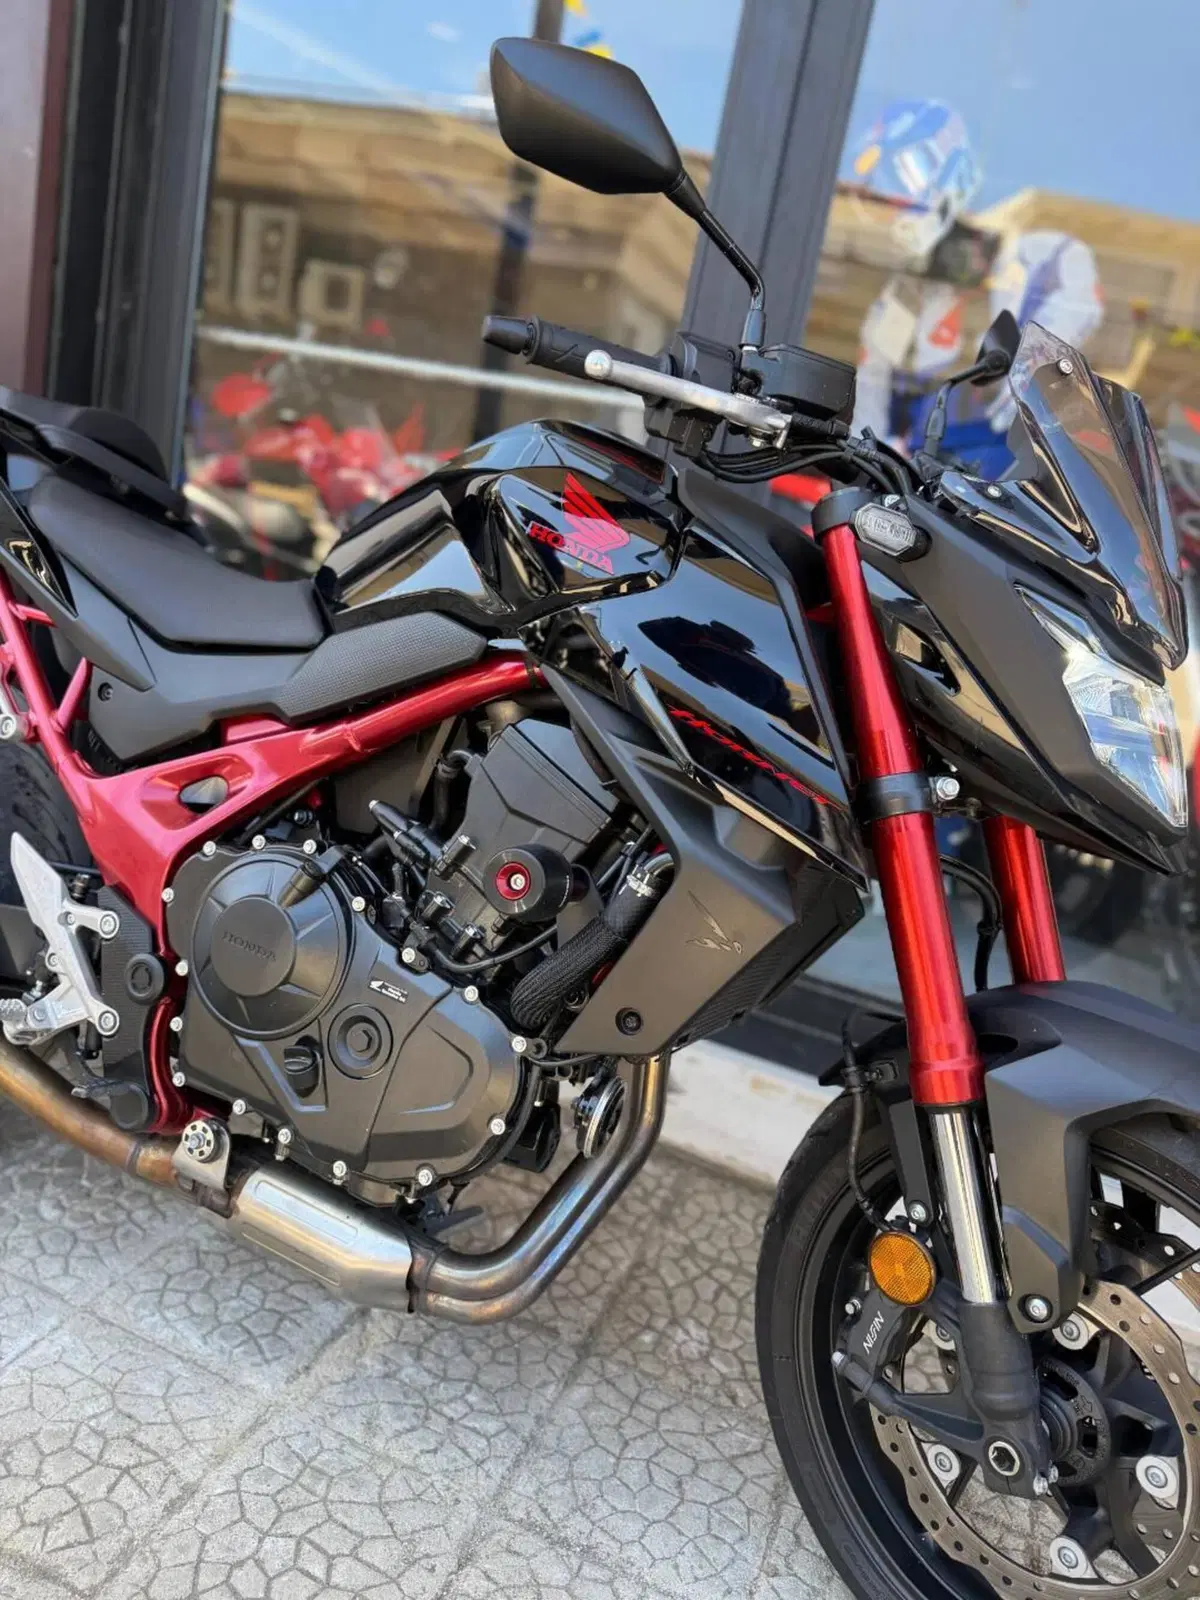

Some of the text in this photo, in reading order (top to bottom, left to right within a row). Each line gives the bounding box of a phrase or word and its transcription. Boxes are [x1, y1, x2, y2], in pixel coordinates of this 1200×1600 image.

[526, 520, 615, 576] HONDA
[221, 930, 277, 962] HONDA
[862, 1310, 885, 1356] NISSIN
